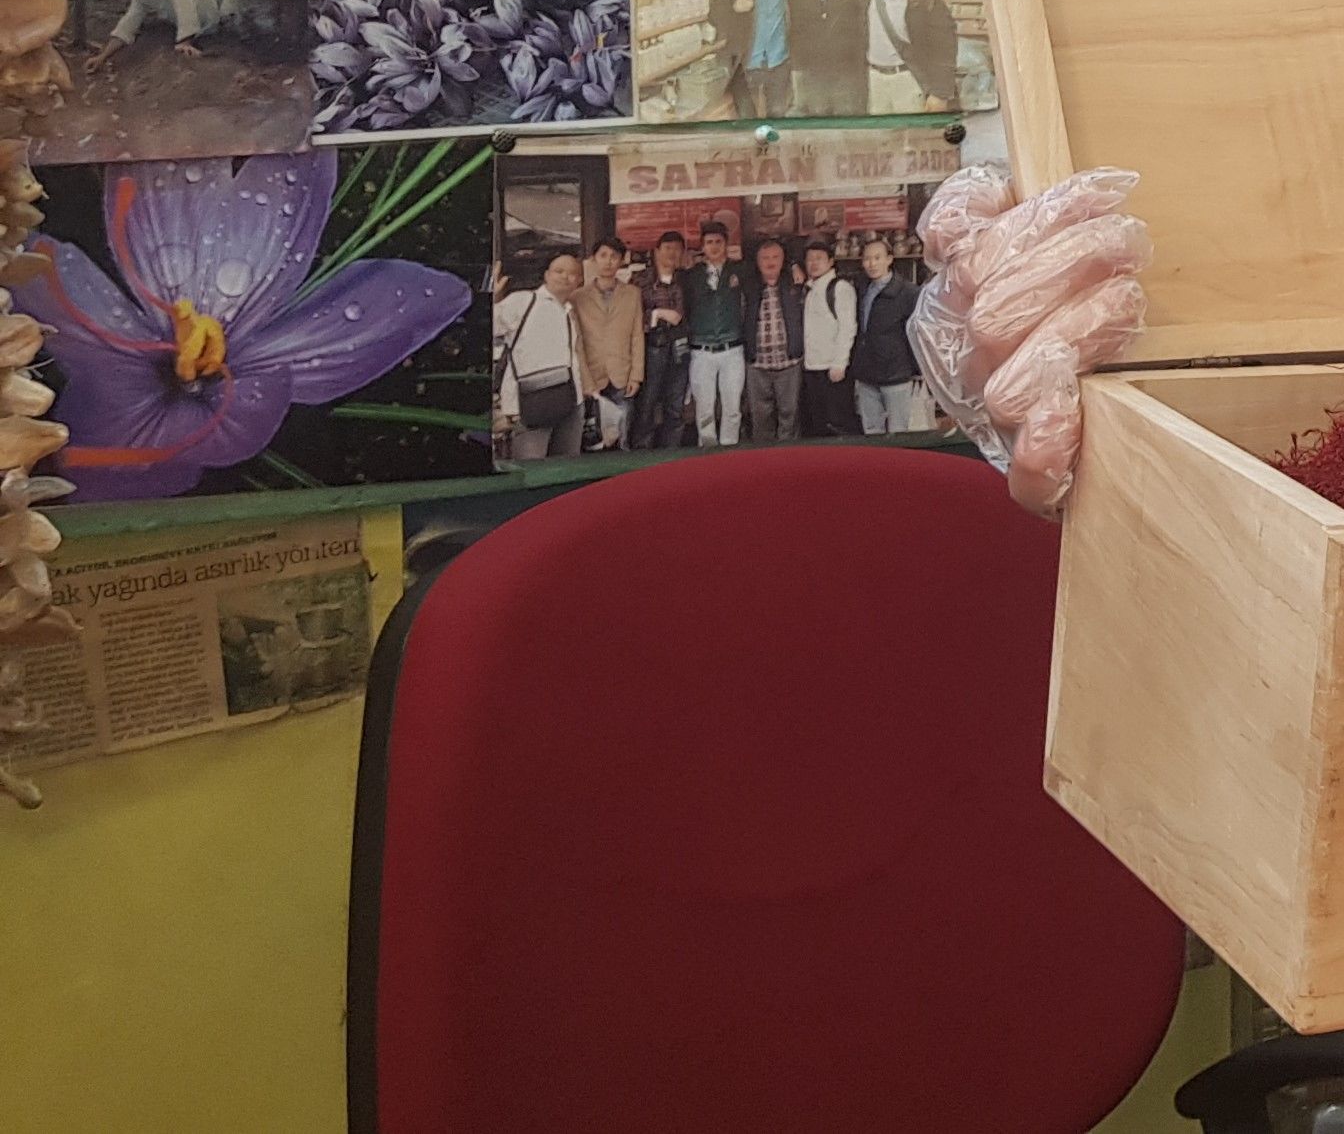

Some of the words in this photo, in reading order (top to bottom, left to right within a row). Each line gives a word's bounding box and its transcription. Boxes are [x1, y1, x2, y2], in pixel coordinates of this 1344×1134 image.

[627, 157, 818, 195] SAFRAN
[51, 578, 82, 606] ak
[88, 564, 188, 607] yağında
[194, 549, 272, 583] asırlık
